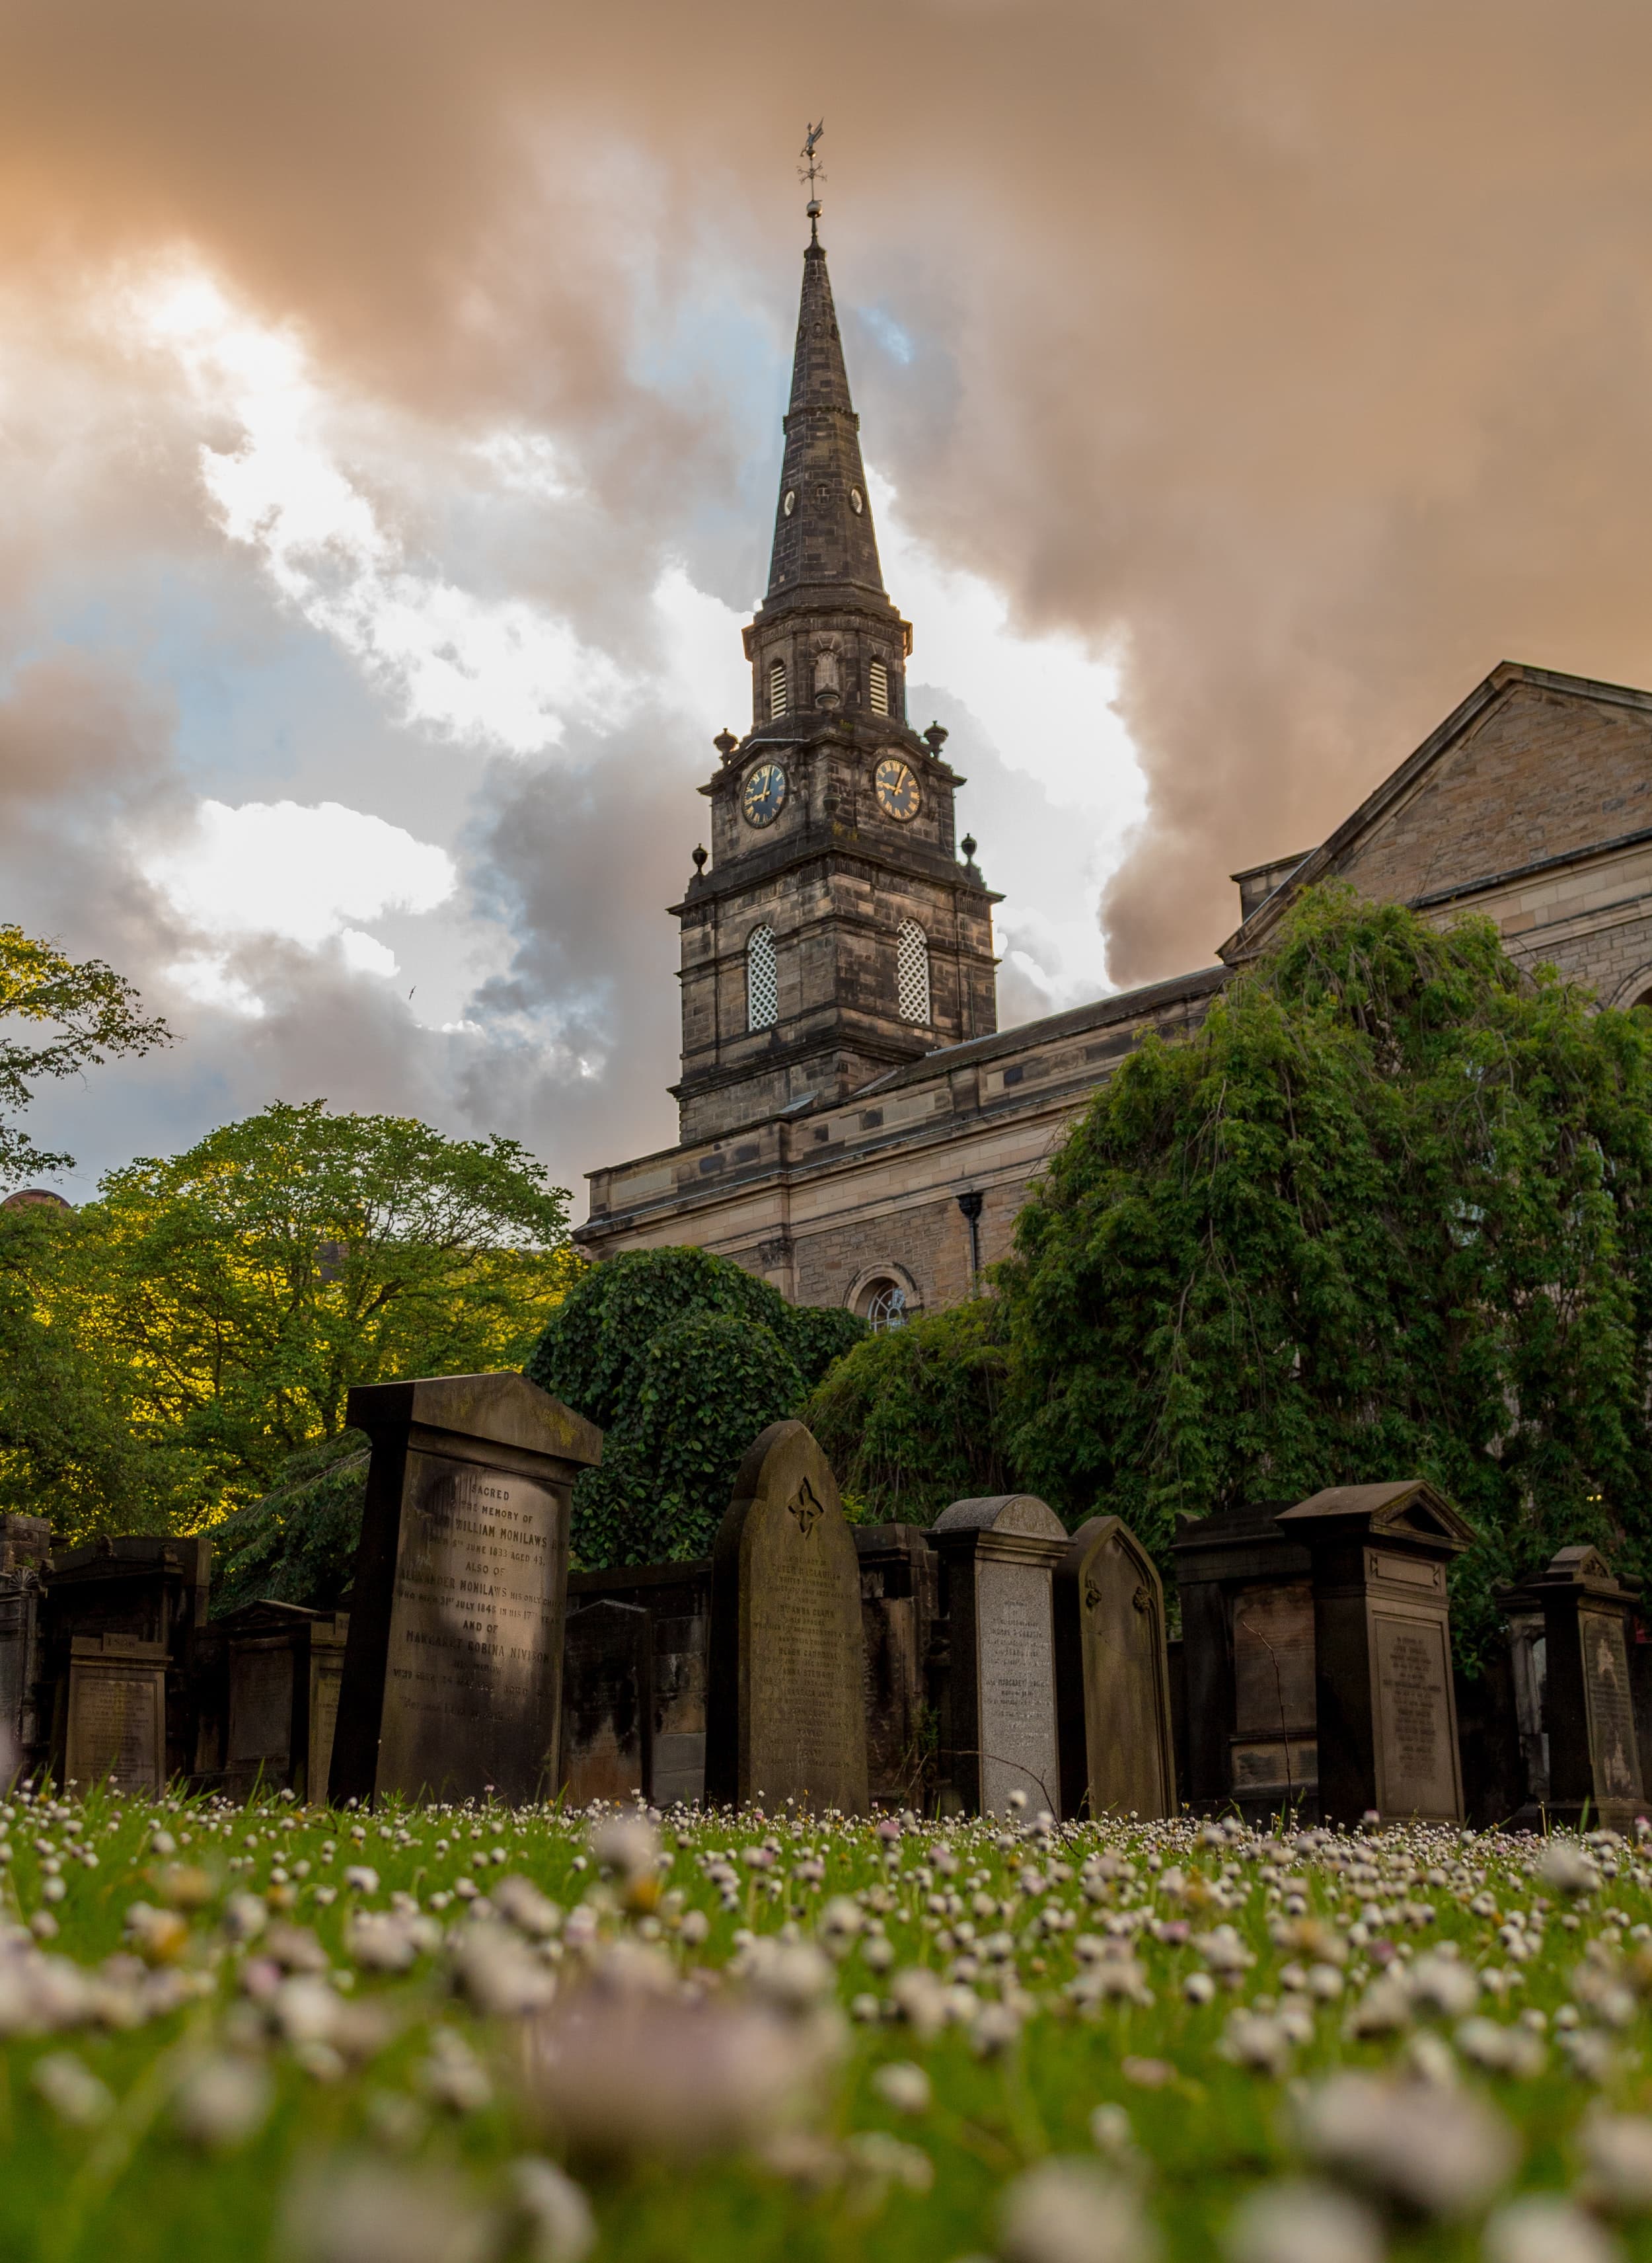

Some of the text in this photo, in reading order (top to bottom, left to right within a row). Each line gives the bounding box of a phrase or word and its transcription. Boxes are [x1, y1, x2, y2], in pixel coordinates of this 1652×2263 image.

[471, 1484, 509, 1501] SACRED
[482, 1505, 519, 1522] MEMORY
[523, 1514, 533, 1523] OF
[455, 1518, 495, 1537] WILLIAM
[500, 1527, 547, 1548] MONILAWS
[466, 1543, 486, 1554] JUNE
[490, 1547, 507, 1557] 1833
[511, 1552, 530, 1562] AGED
[465, 1561, 506, 1576] ALSO OF
[460, 1580, 507, 1597] MONILAWS
[510, 1592, 522, 1601] HIS
[524, 1595, 541, 1605] ONLY
[456, 1600, 475, 1611] JULY
[500, 1607, 507, 1616] IN
[509, 1609, 521, 1618] HIS
[463, 1620, 498, 1634] AND OF
[406, 1630, 549, 1664] MARGARET ROBINA NIVISON
